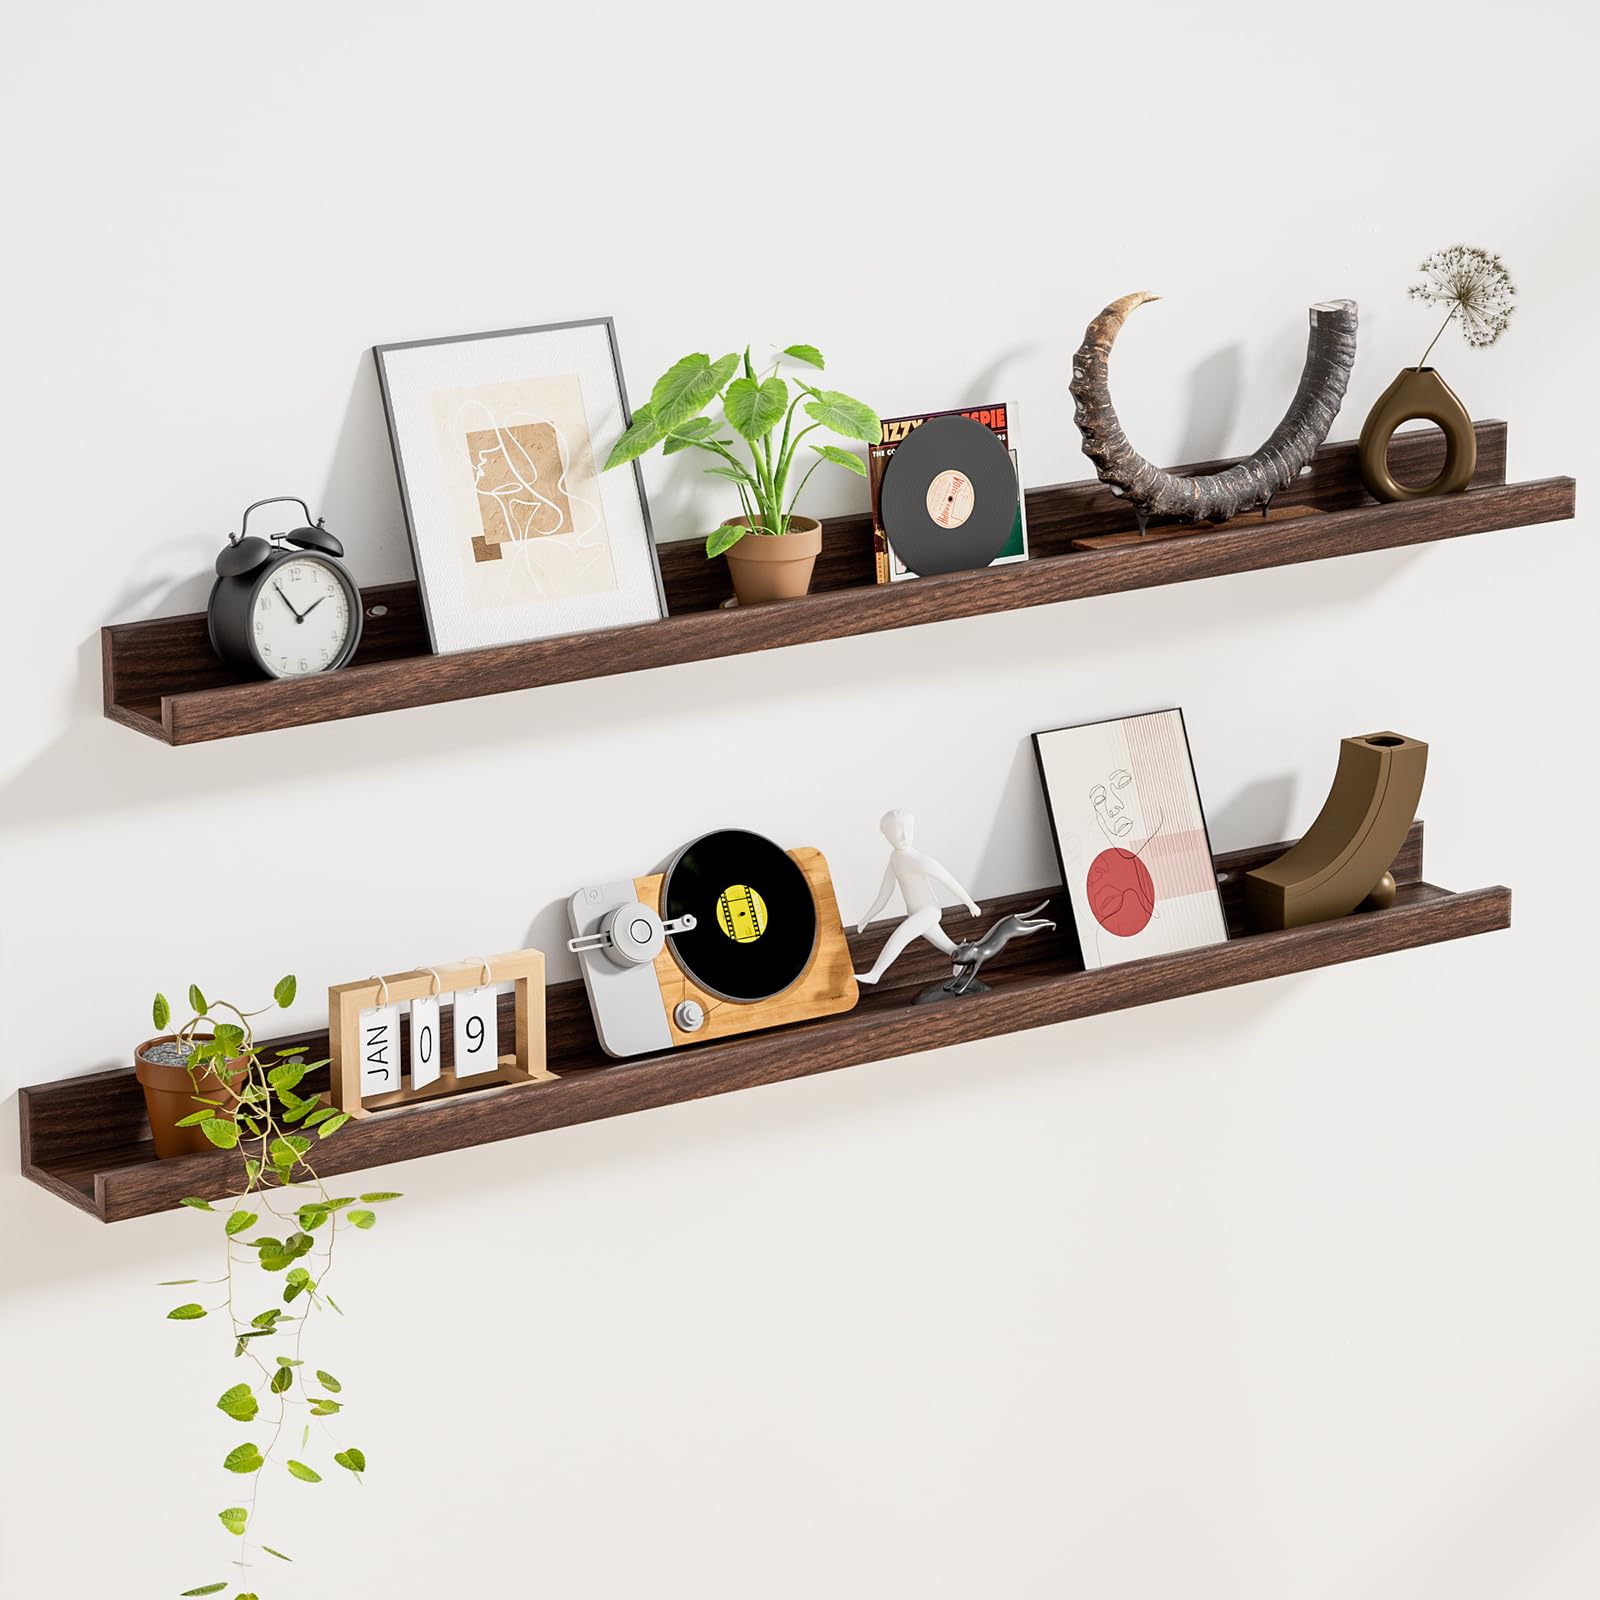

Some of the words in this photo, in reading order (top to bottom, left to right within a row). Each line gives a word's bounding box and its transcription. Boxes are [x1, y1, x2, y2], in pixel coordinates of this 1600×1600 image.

[881, 419, 924, 443] IZZY
[872, 450, 885, 458] THE
[290, 567, 302, 582] 12
[312, 570, 318, 583] 1
[327, 585, 335, 598] 2
[336, 606, 343, 619] 3
[321, 649, 329, 661] 5
[281, 656, 288, 670] 7
[298, 658, 308, 671] 6
[366, 1025, 389, 1081] JAN
[419, 1025, 433, 1064] 0
[465, 1015, 485, 1053] 9
